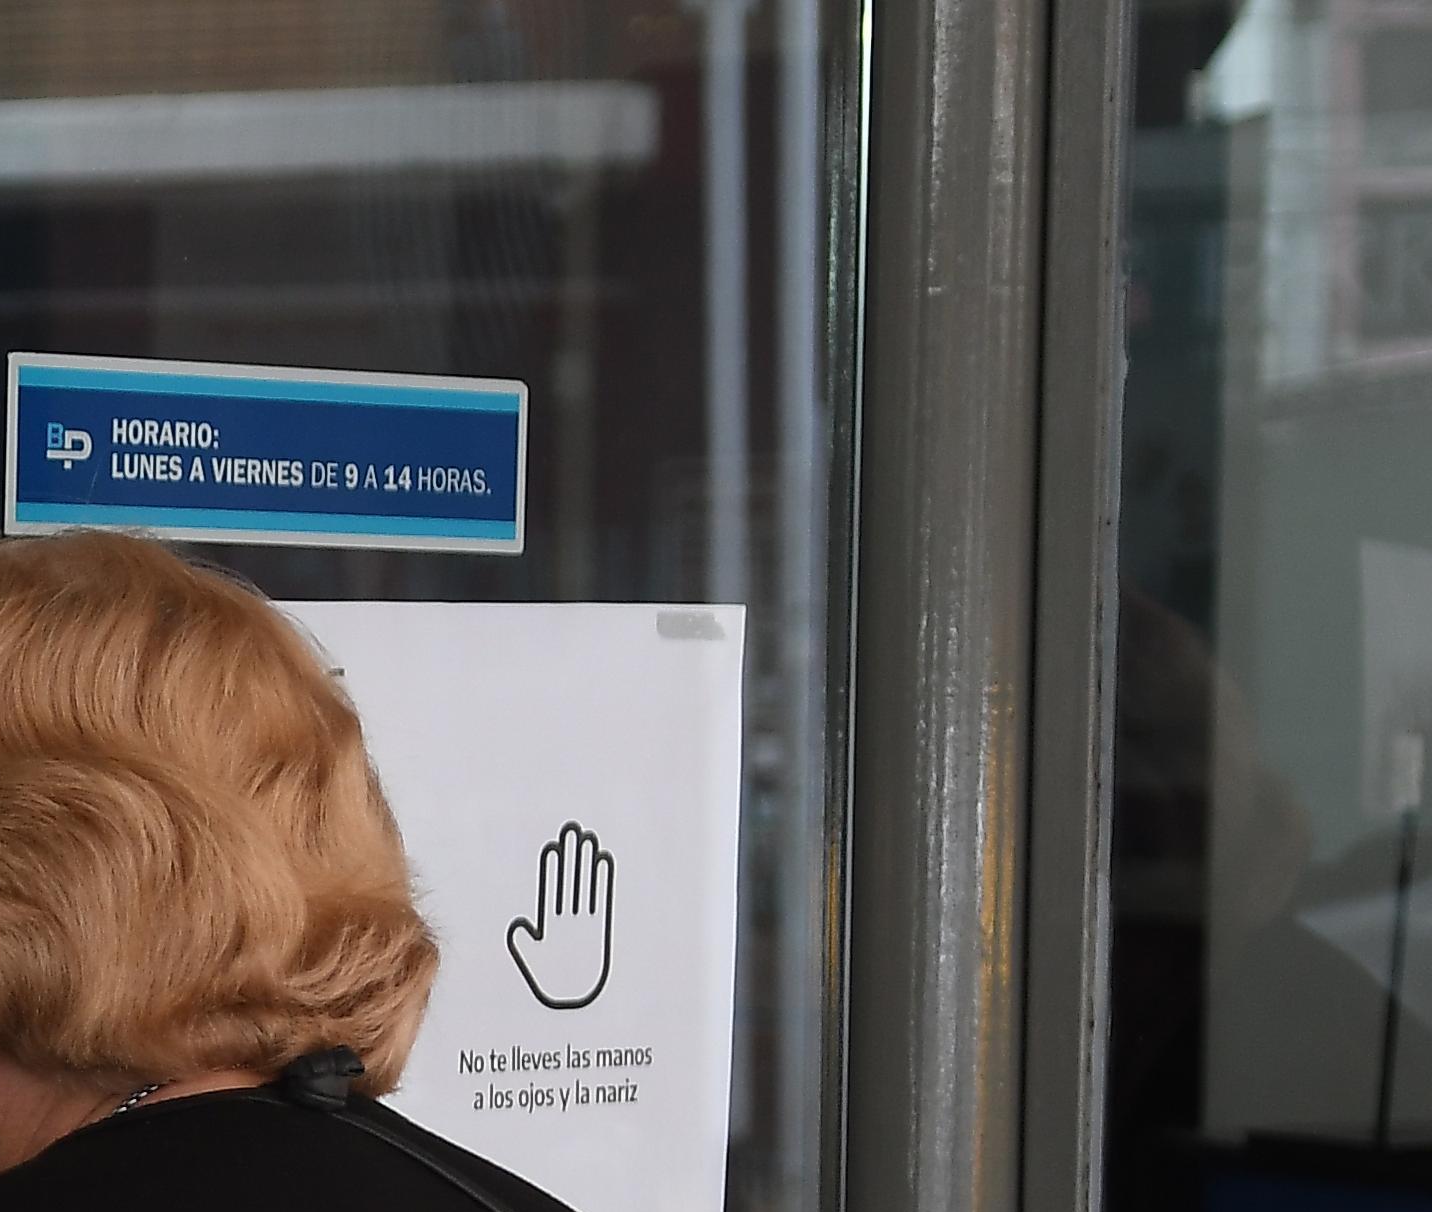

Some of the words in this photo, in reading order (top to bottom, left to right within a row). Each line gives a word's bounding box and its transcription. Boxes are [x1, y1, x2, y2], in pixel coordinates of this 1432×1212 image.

[112, 418, 219, 448] HORARIO:
[111, 452, 182, 481] LUNES
[189, 456, 205, 482] A
[211, 457, 304, 486] VIERNES
[311, 461, 338, 488] DE
[344, 463, 358, 489] 9
[363, 463, 378, 489] A
[383, 465, 412, 491] 14
[418, 466, 492, 495] HORAS.
[458, 1049, 485, 1074] No
[490, 1049, 507, 1073] te
[511, 1045, 561, 1071] lleves
[566, 1043, 591, 1068] las
[596, 1047, 653, 1067] manos
[473, 1091, 483, 1110] a
[489, 1083, 514, 1109] los
[518, 1082, 554, 1113] ojos
[559, 1087, 571, 1112] y
[575, 1079, 590, 1104] la
[596, 1078, 638, 1103] nariz
